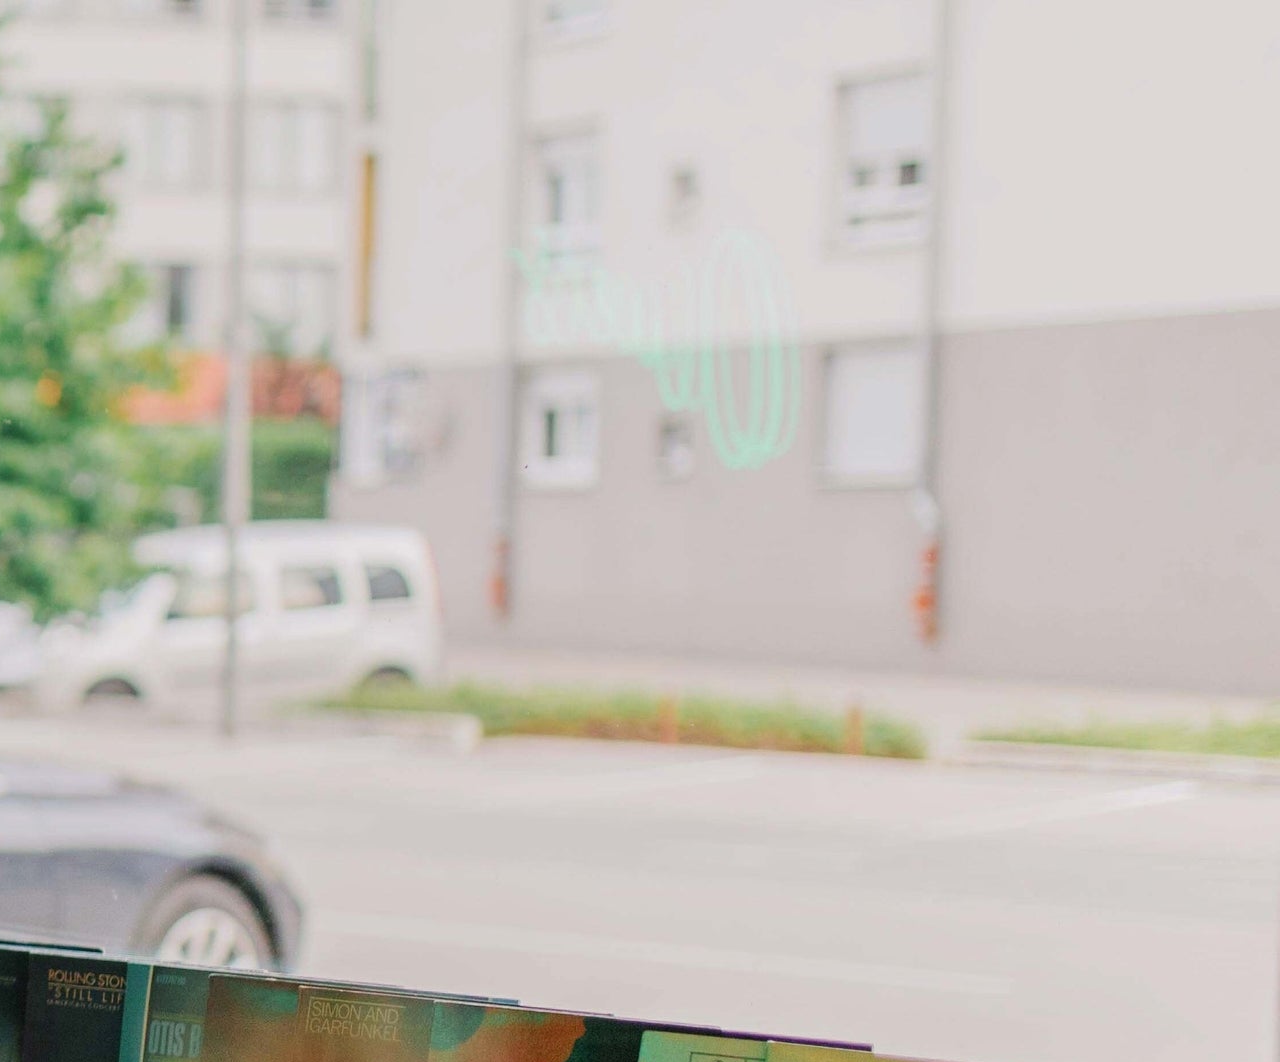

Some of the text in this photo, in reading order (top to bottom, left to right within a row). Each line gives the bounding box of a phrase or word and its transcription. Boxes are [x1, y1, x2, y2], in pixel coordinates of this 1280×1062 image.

[48, 968, 96, 986] ROLLING
[312, 1000, 399, 1025] SIMON AND
[149, 1020, 183, 1056] OTIS
[309, 1017, 402, 1043] GARFUNKEL
